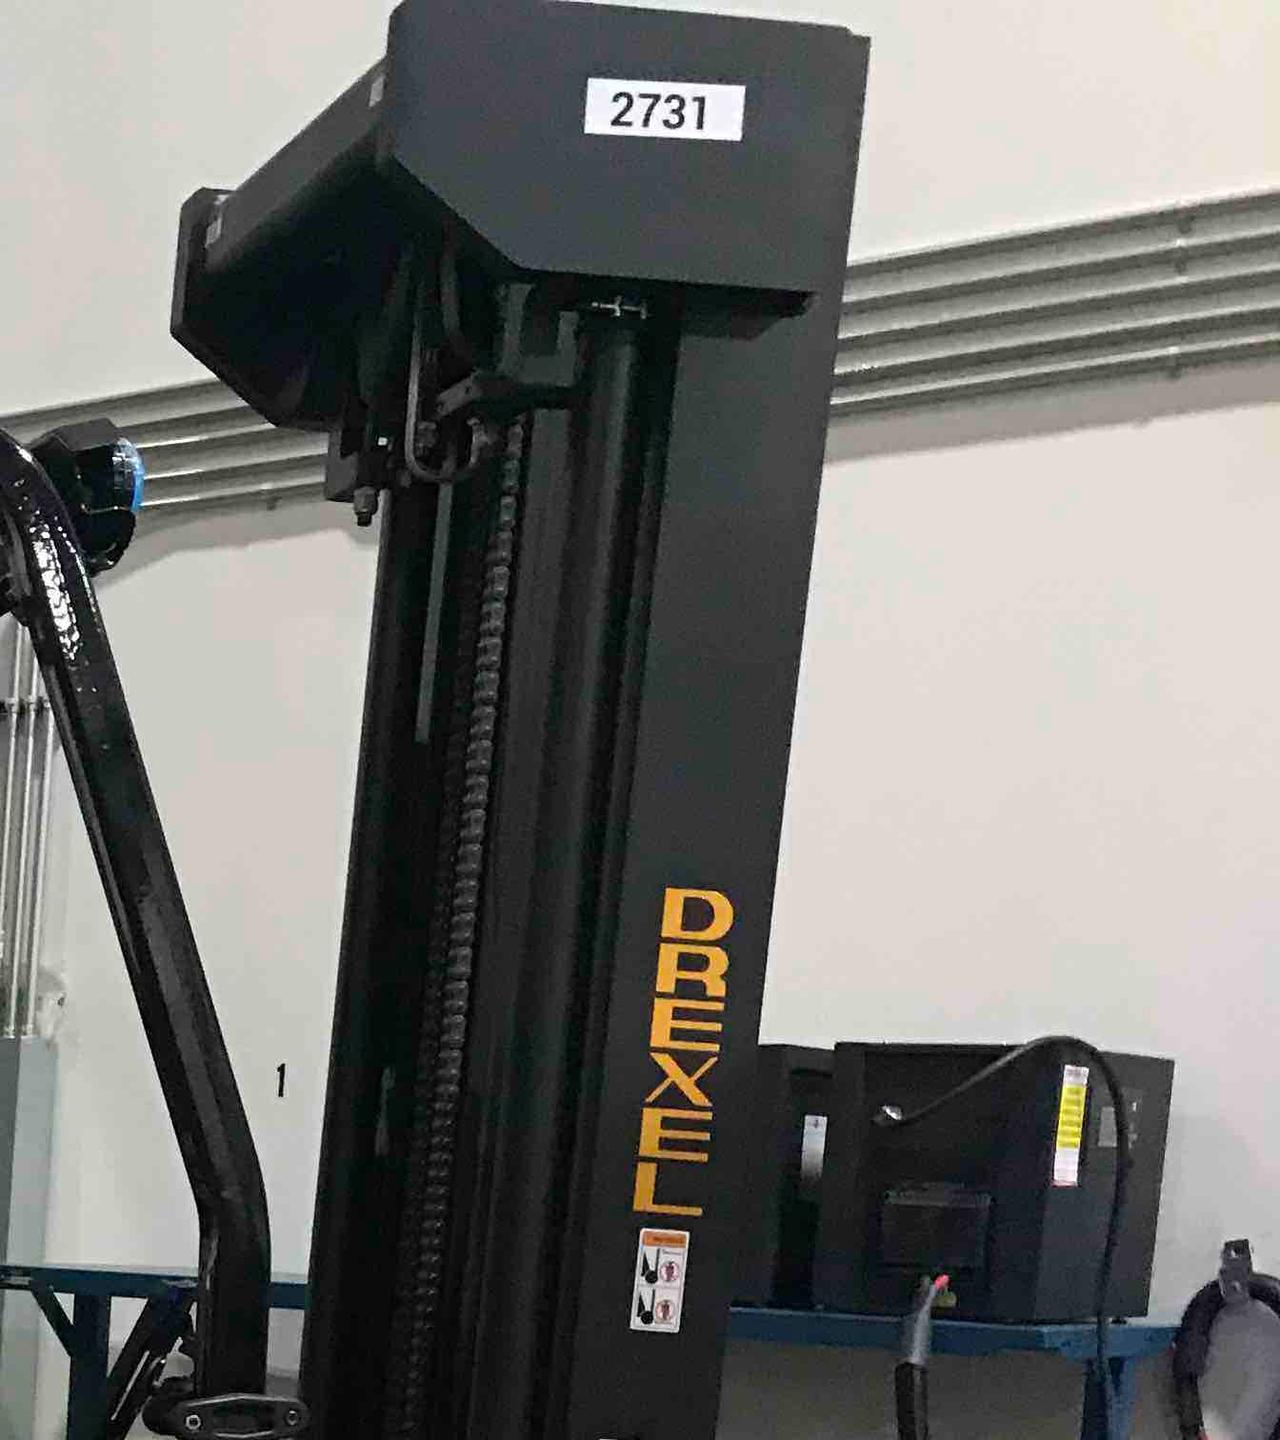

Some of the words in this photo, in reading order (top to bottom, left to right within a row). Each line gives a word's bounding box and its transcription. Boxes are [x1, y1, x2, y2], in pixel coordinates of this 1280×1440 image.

[610, 91, 706, 130] 2731
[632, 887, 734, 1217] DREXEL
[276, 1063, 286, 1098] 1
